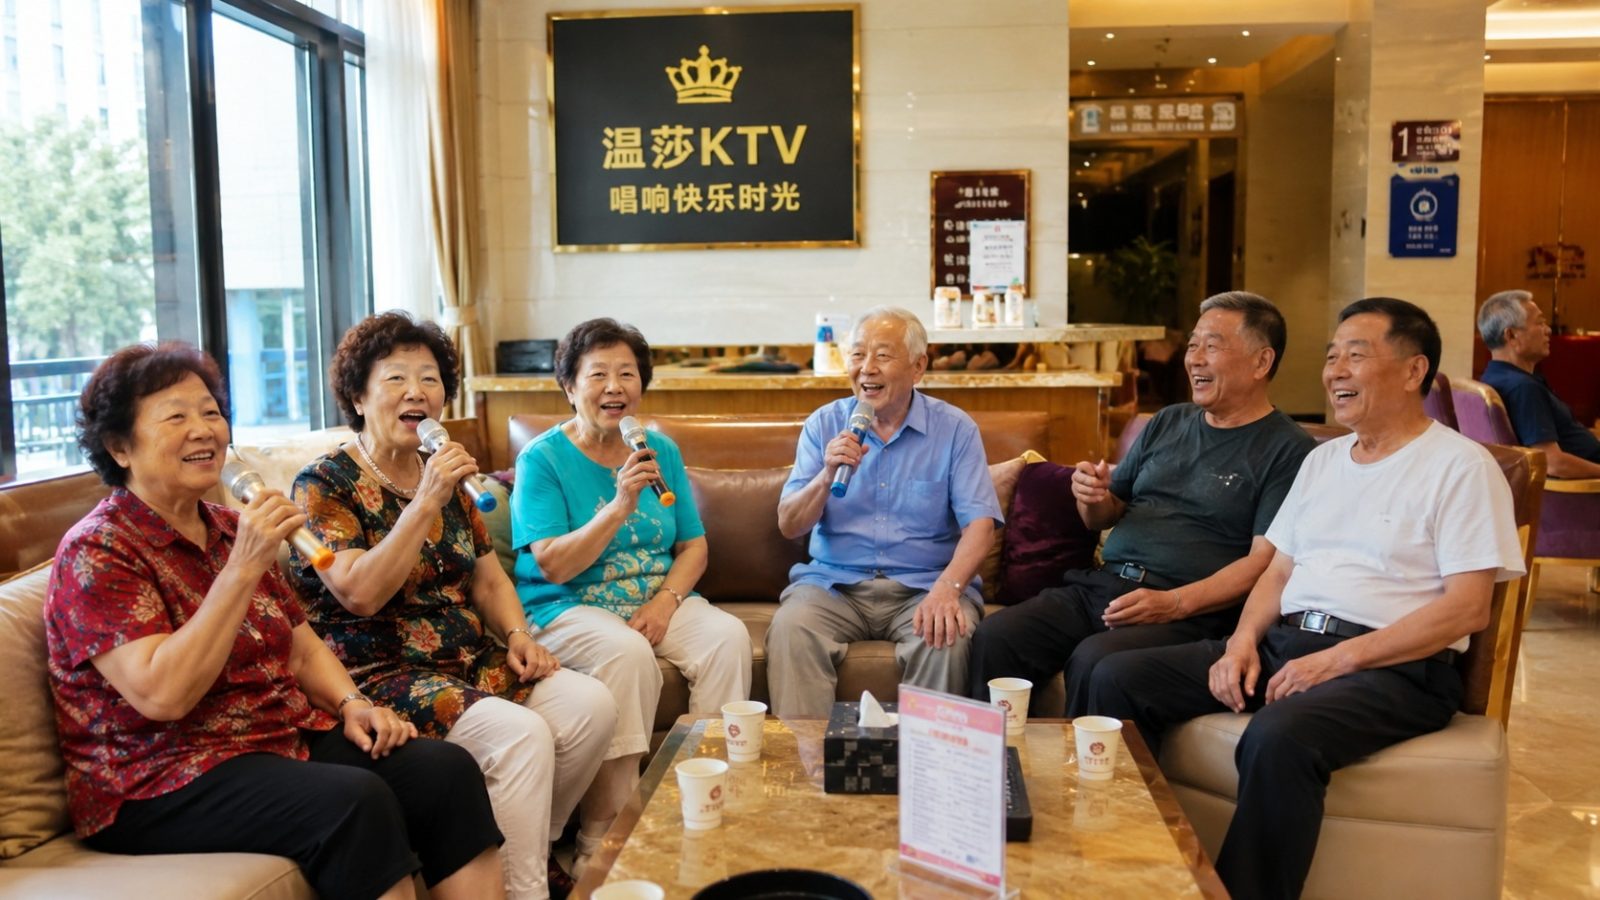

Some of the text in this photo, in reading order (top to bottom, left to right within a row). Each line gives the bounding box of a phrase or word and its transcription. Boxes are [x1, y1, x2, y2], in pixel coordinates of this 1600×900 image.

[602, 124, 807, 170] 温莎KTV
[1398, 127, 1409, 157] 1
[610, 182, 801, 214] 唱响快乐时光
